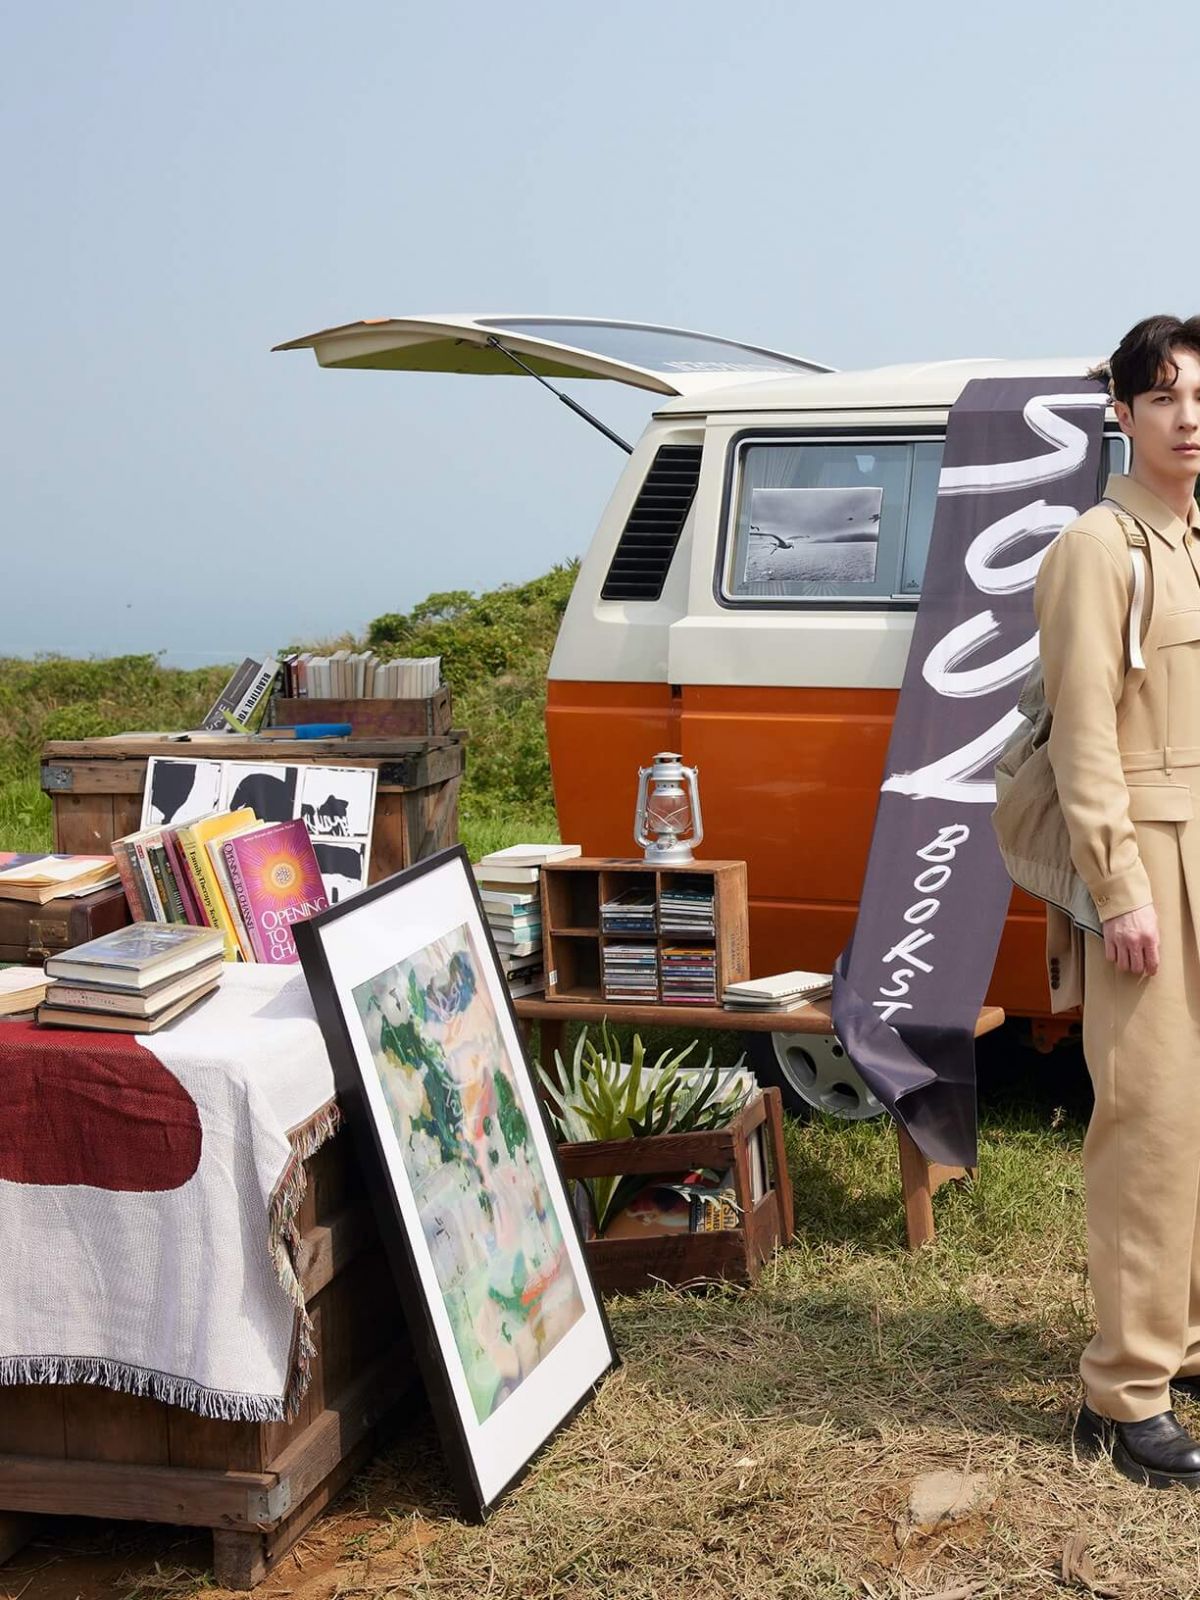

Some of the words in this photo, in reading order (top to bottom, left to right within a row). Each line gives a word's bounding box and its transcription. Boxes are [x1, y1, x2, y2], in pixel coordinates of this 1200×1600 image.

[244, 672, 272, 709] BEAUTIFUL
[189, 850, 201, 877] Family
[199, 876, 211, 907] Therapy
[261, 896, 327, 930] OPENING
[872, 822, 970, 1022] BOOKST
[266, 927, 288, 946] TO
